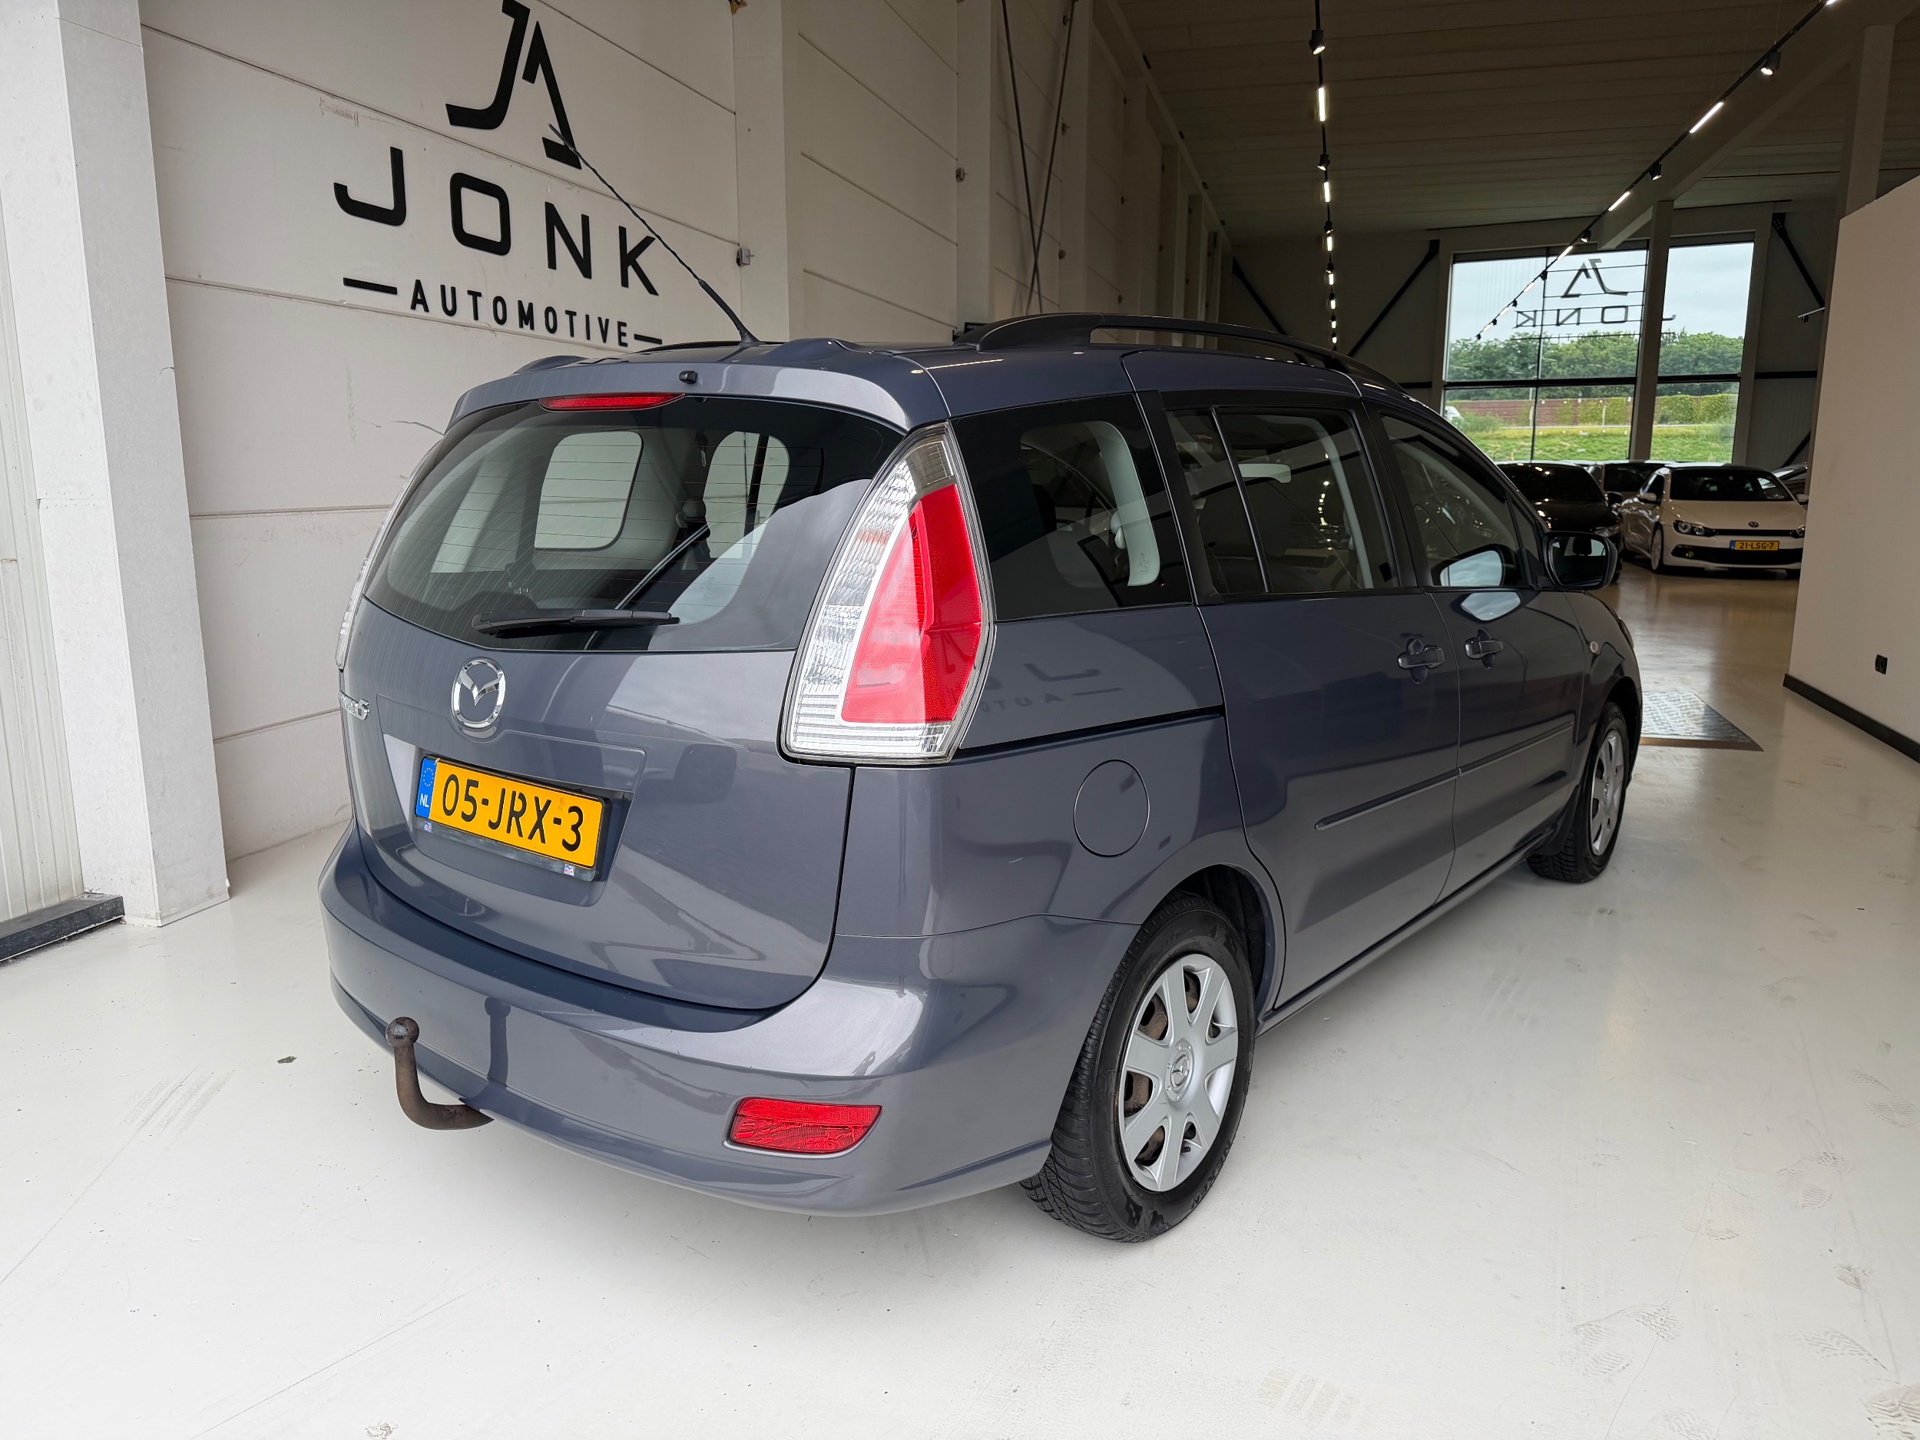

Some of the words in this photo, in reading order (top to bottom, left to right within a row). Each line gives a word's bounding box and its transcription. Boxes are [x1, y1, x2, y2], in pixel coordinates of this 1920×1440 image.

[333, 146, 659, 296] JONK
[410, 278, 629, 348] AUTOMOTIVE
[419, 793, 430, 808] NL
[441, 773, 584, 852] 05-JRX-3
